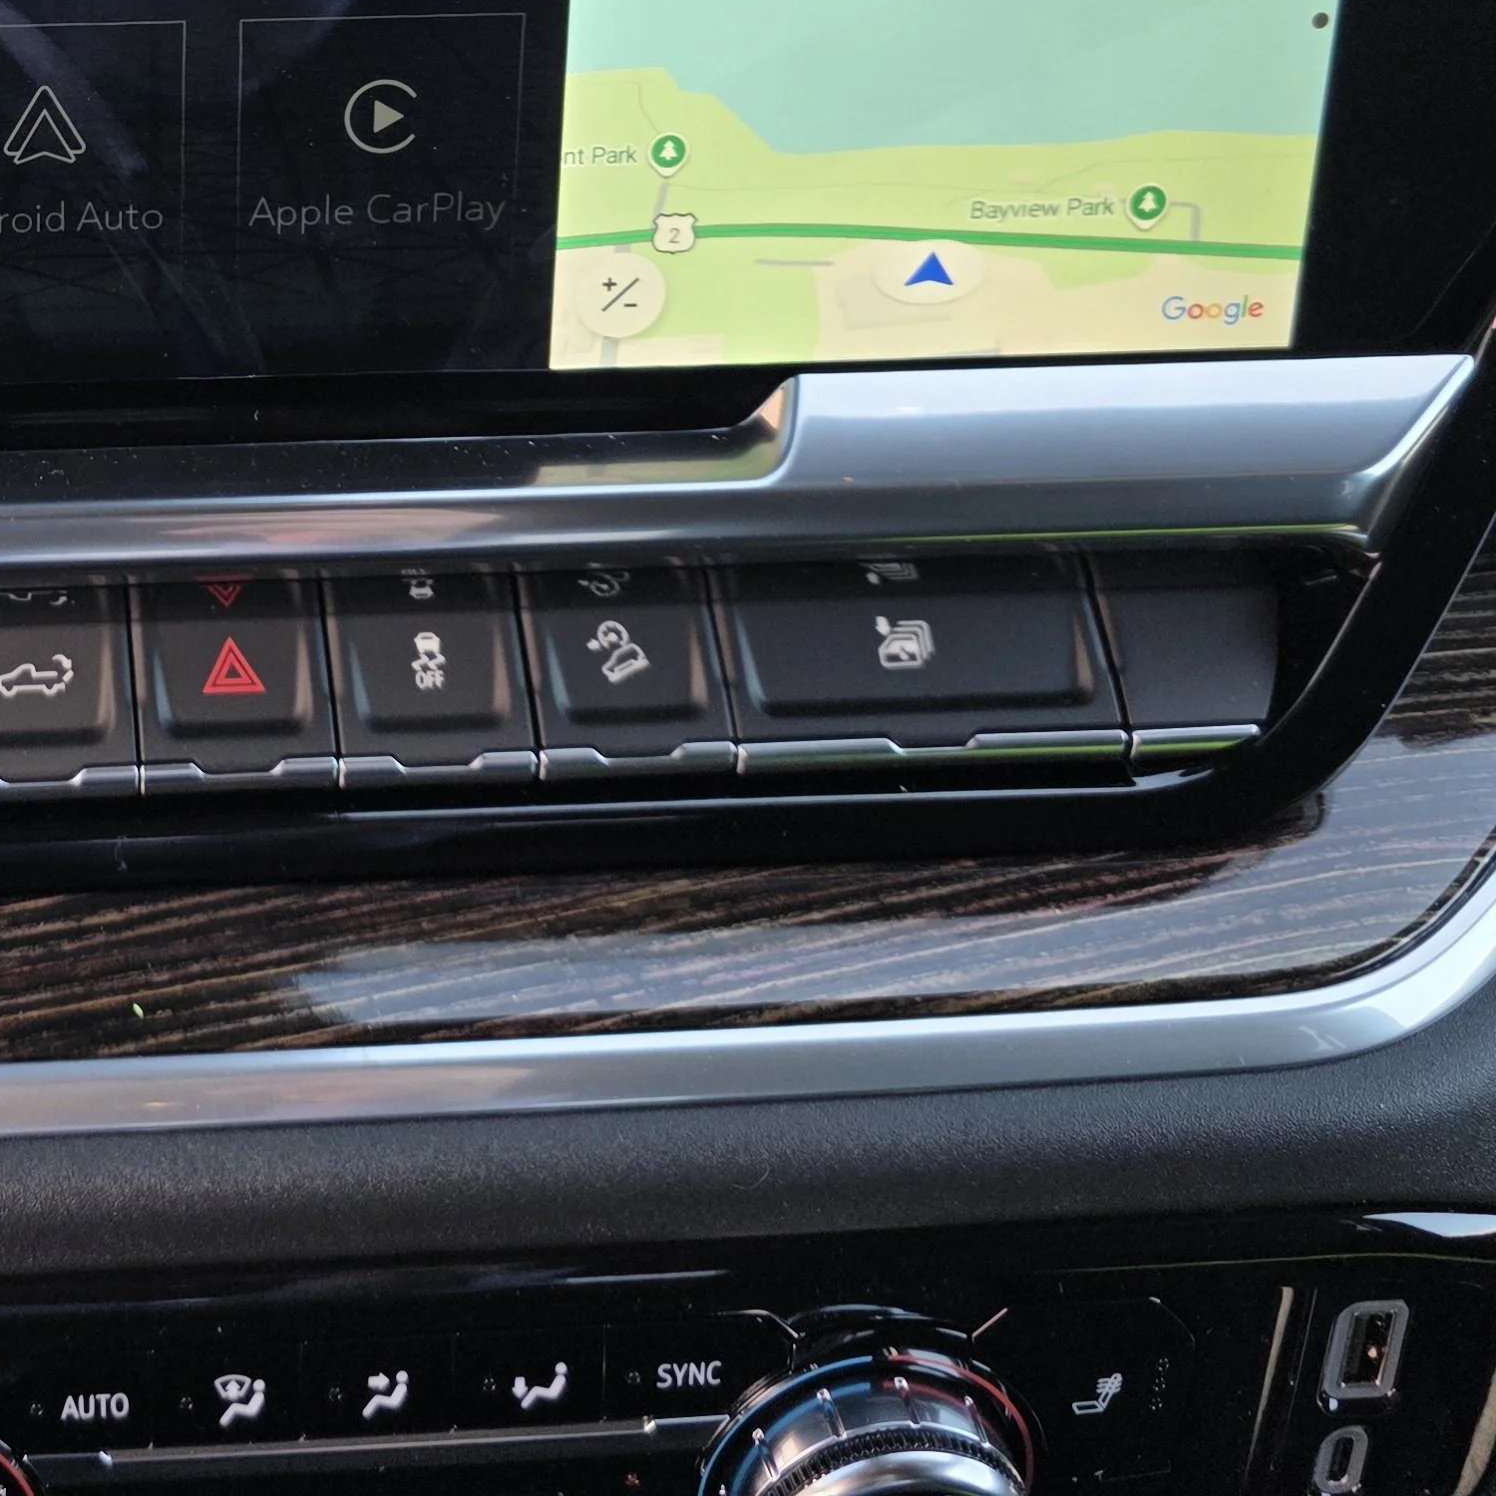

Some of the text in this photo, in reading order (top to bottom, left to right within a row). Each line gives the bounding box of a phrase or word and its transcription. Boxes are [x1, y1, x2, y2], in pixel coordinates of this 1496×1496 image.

[591, 145, 637, 164] Park
[76, 201, 164, 232] Auto
[248, 190, 506, 235] Apple CarPlay
[969, 197, 1115, 223] Bayview Park
[668, 227, 682, 244] 2
[1161, 294, 1265, 325] Google
[415, 669, 444, 690] OFF
[656, 1360, 722, 1389] SYNC
[60, 1392, 130, 1421] AUTO
